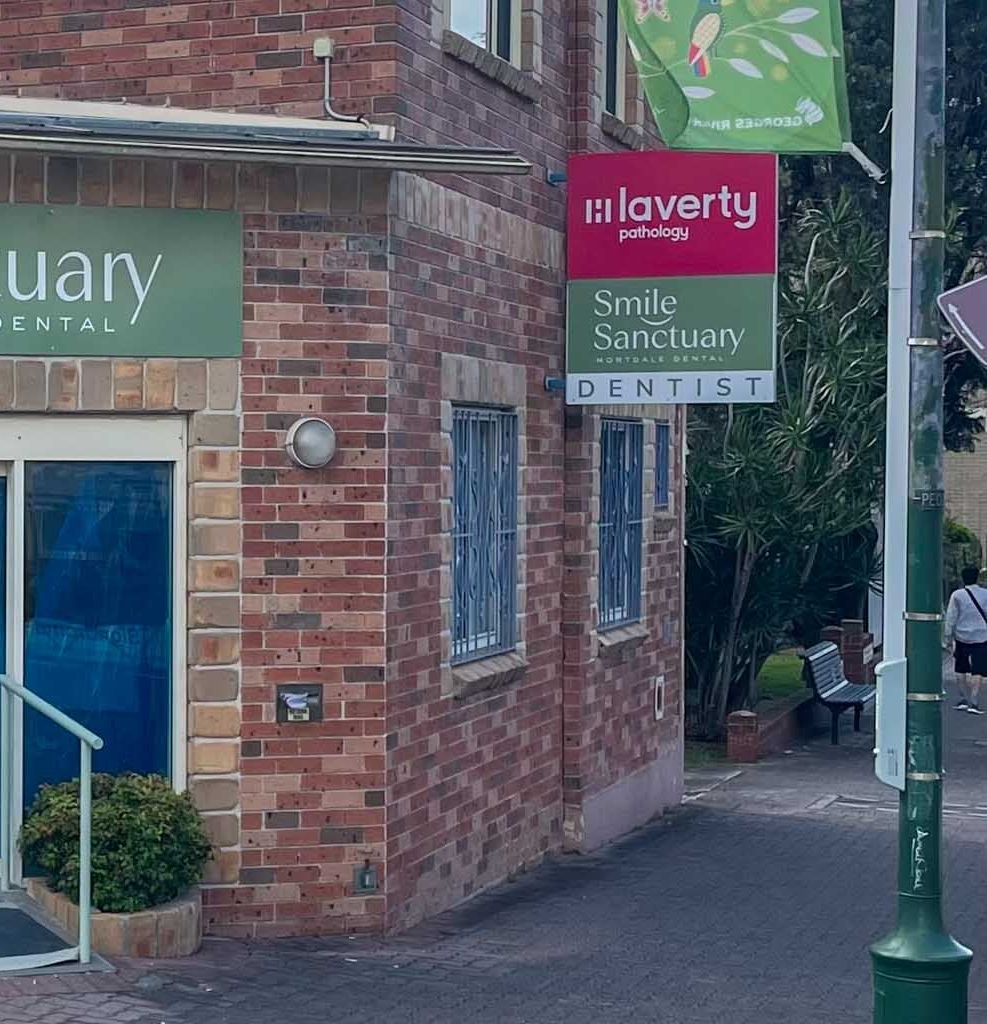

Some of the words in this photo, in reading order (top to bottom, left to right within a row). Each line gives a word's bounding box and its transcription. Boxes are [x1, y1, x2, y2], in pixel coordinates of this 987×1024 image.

[619, 184, 757, 230] laverty
[619, 224, 689, 243] pathology
[594, 288, 678, 317] Smile
[593, 323, 746, 356] Sanctuary
[596, 355, 665, 364] MORTDALE
[673, 354, 725, 363] DENTAL
[578, 377, 762, 398] DENTIST
